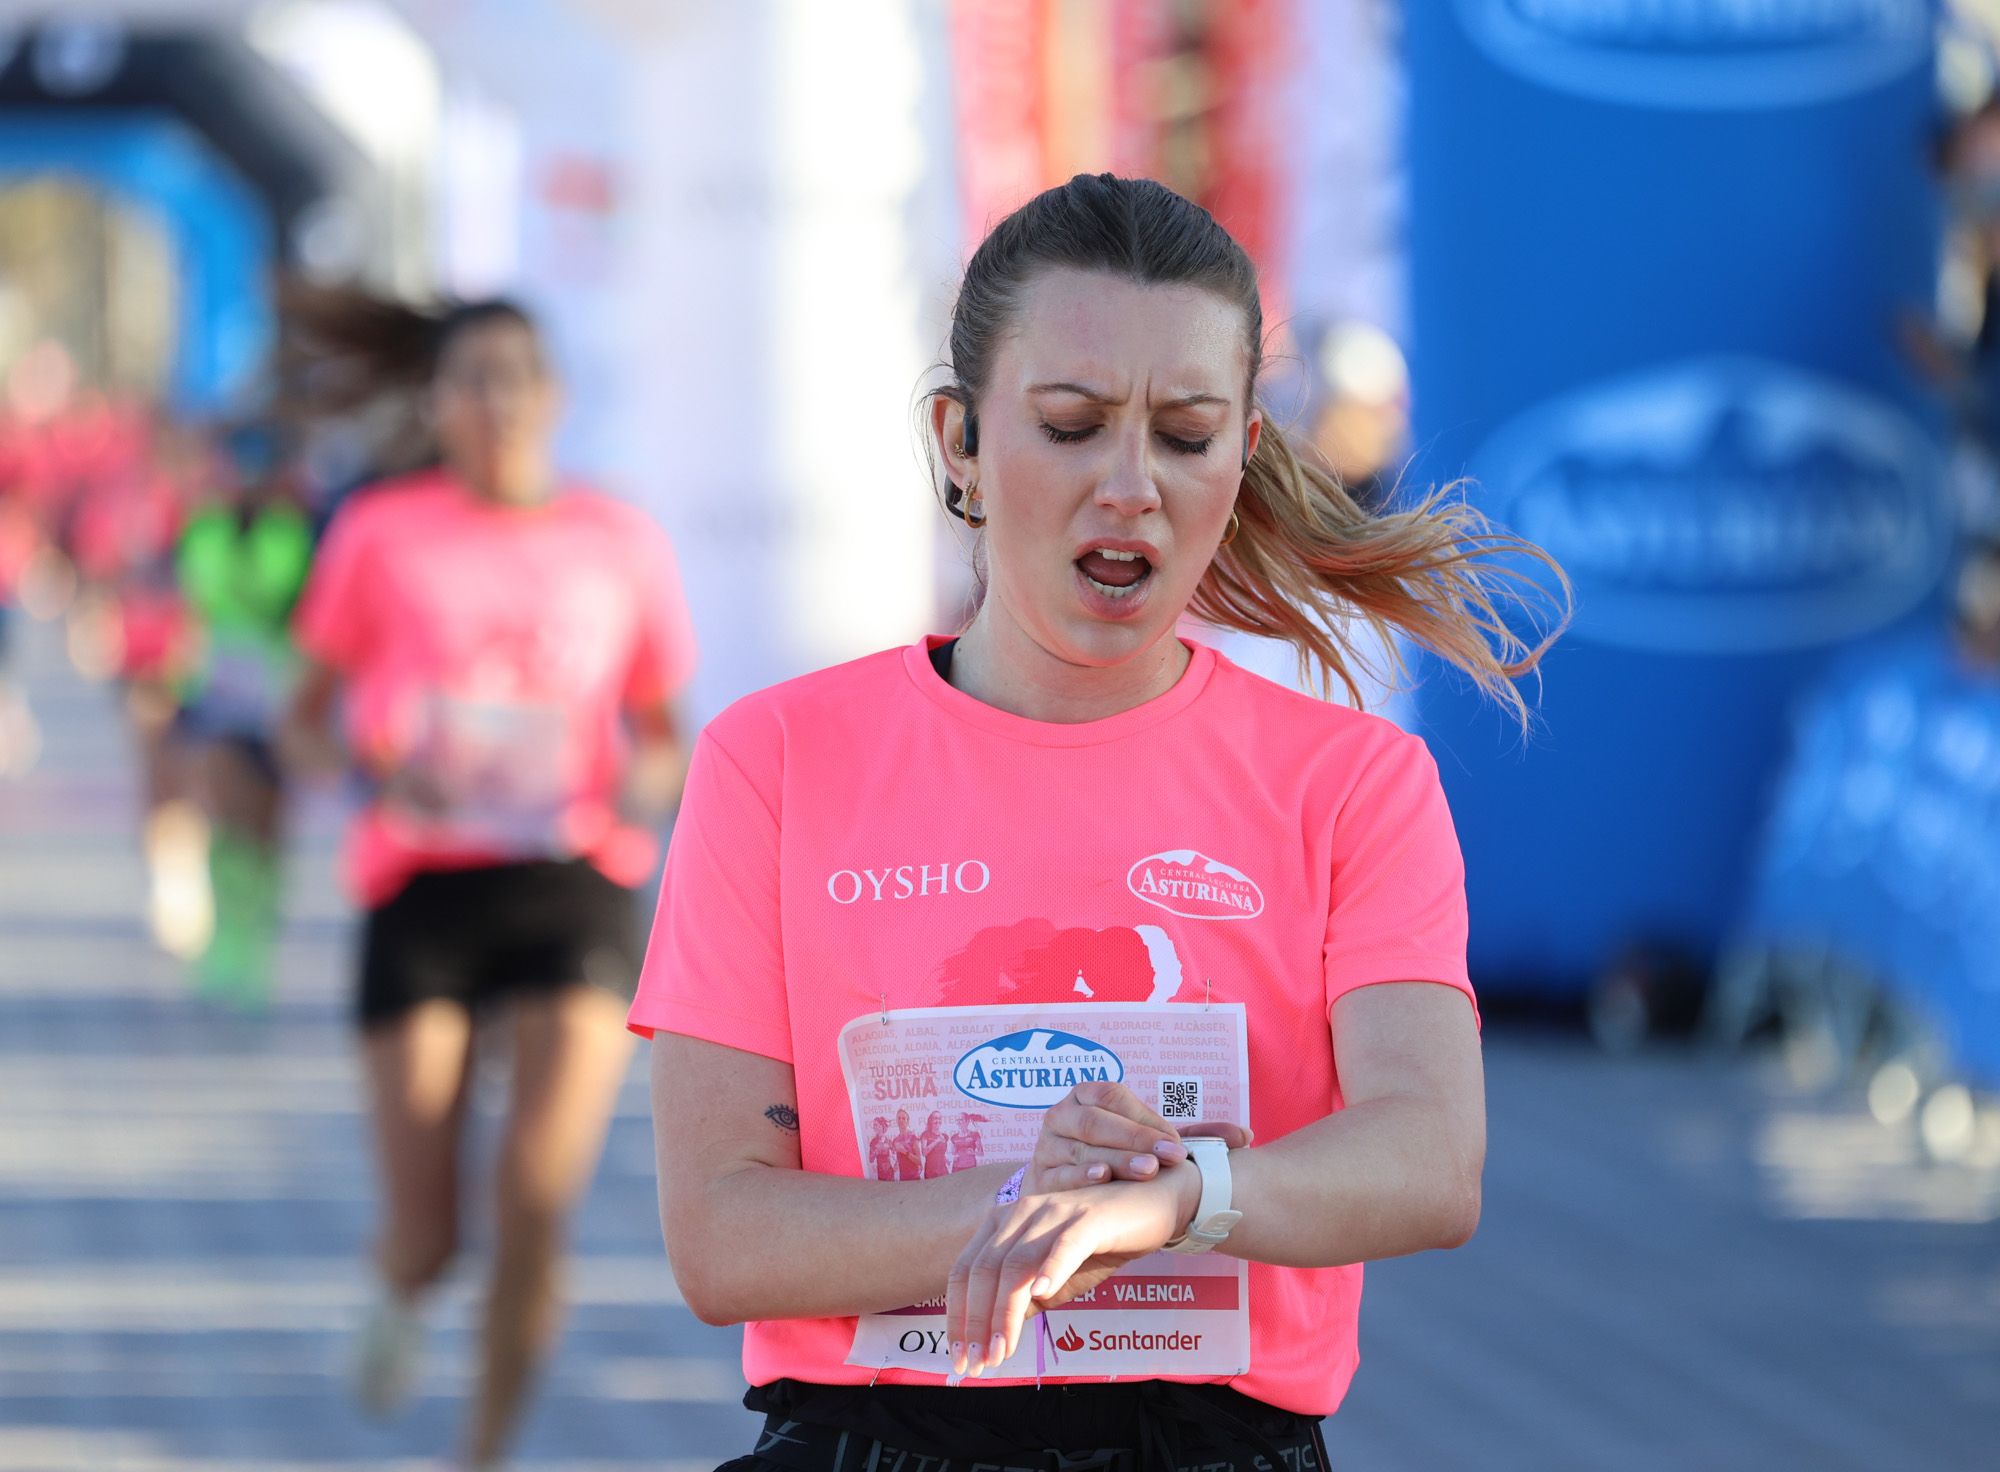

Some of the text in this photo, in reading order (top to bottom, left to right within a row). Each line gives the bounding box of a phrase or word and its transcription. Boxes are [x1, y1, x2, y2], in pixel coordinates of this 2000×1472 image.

[827, 859, 990, 904] OYSHO
[1160, 868, 1206, 880] CENTRAL
[1138, 868, 1255, 913] ASTURIANA
[868, 1062, 937, 1079] TU DORSAL
[992, 1055, 1105, 1065] CENTRAL LECHERA
[966, 1059, 1109, 1089] ASTURIANA
[874, 1076, 938, 1101] SUMA
[1113, 1284, 1195, 1303] VALENCIA
[1089, 1329, 1203, 1351] Santander
